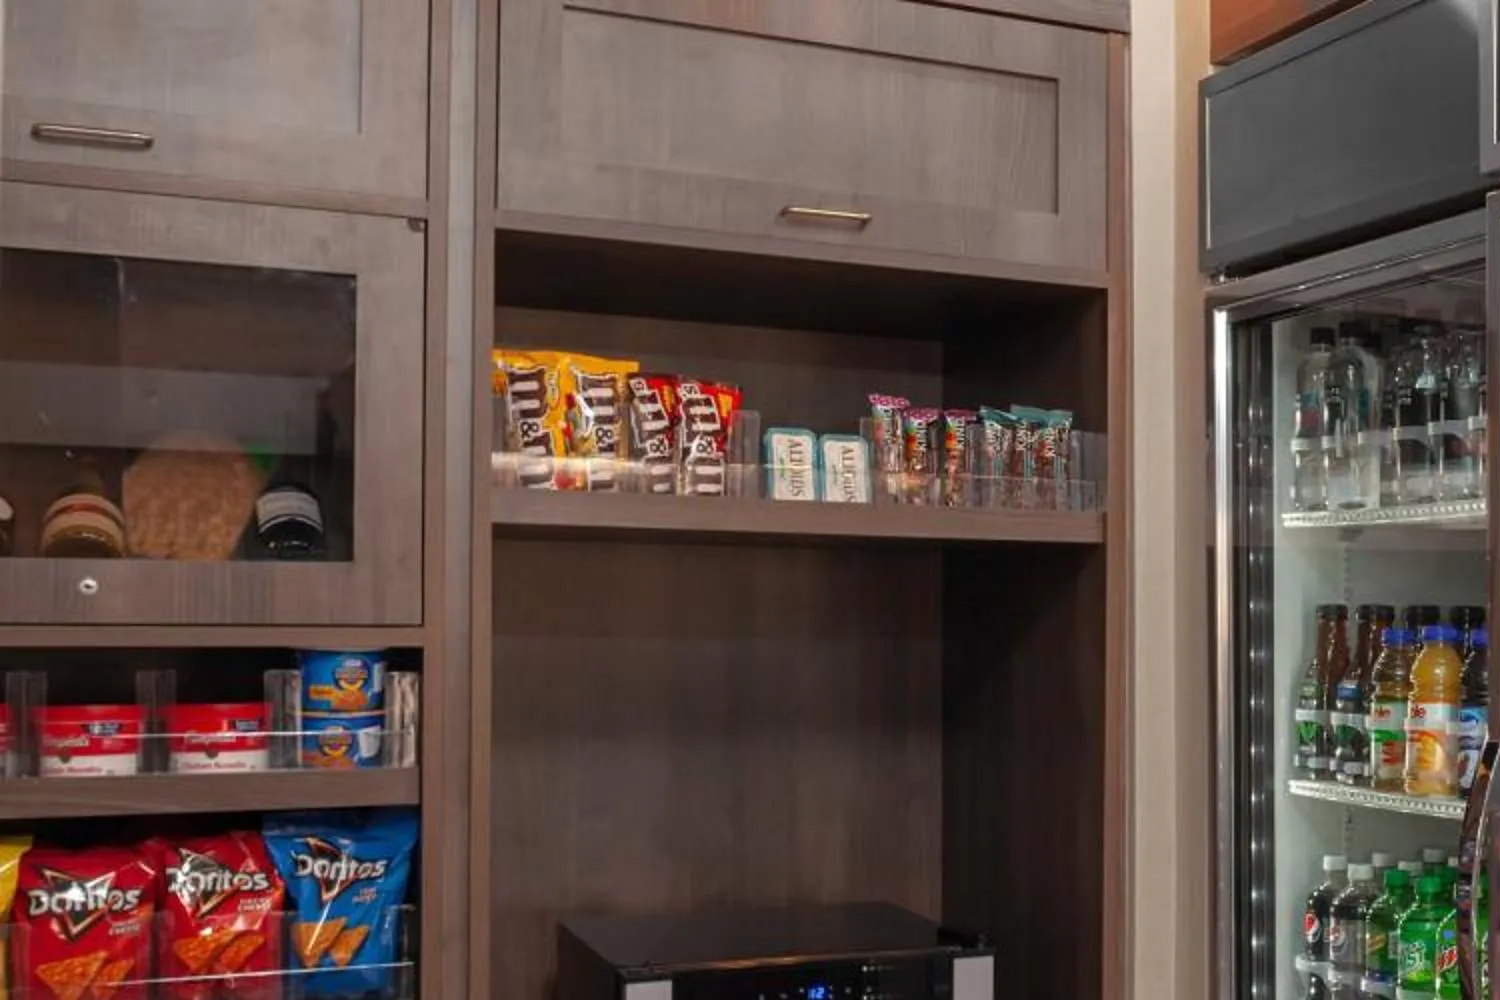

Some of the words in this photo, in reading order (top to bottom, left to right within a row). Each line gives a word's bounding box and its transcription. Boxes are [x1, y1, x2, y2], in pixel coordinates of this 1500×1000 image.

[165, 864, 270, 895] Doritos
[294, 852, 389, 880] Doritos
[27, 881, 143, 917] Doritos
